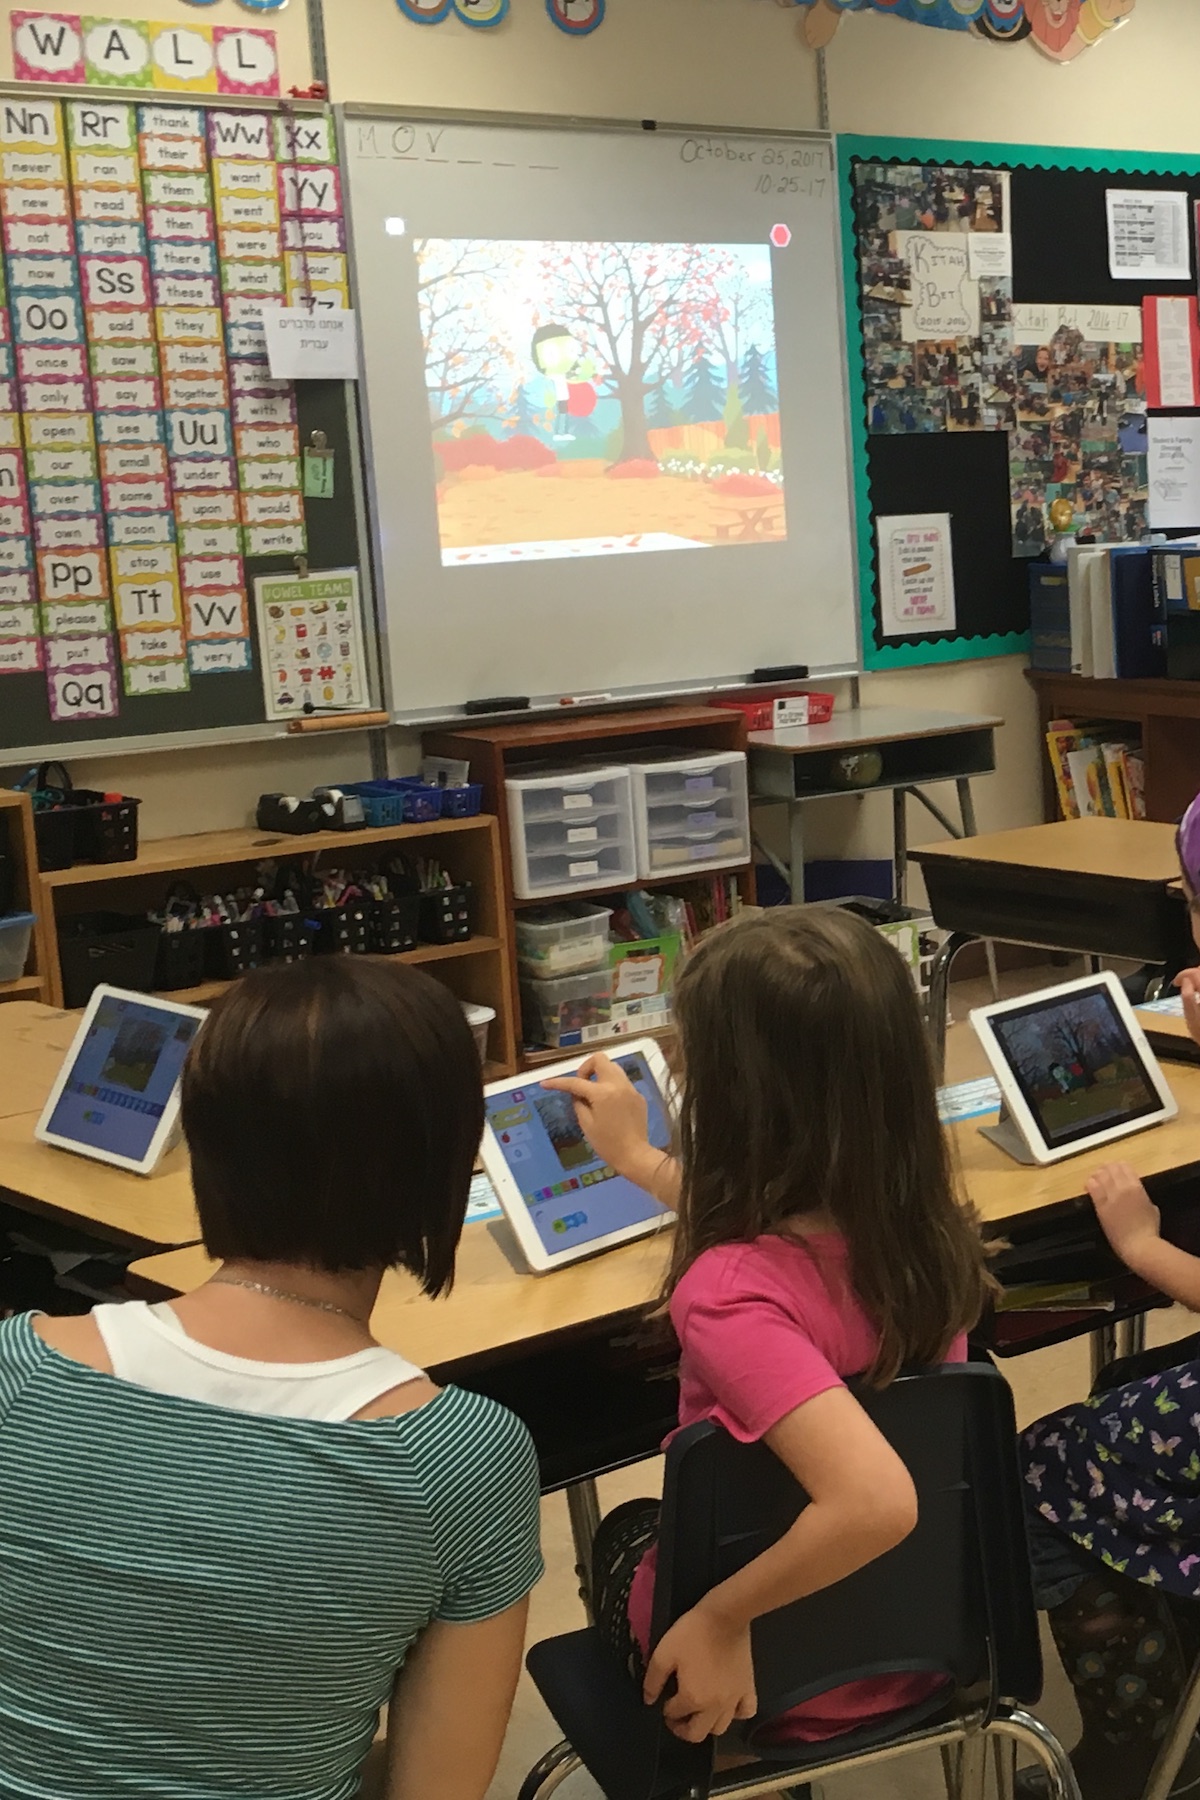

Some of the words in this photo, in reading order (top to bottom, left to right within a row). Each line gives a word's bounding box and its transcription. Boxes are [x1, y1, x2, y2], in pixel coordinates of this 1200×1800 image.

[5, 107, 49, 135] Nn
[80, 111, 119, 137] Rr
[153, 116, 190, 128] thank
[216, 121, 264, 144] Ww
[285, 126, 322, 150] Xx
[157, 148, 188, 160] their
[680, 139, 757, 163] October
[12, 163, 52, 173] never
[93, 165, 117, 175] ran
[230, 172, 261, 183] want
[161, 183, 194, 195] them
[289, 177, 328, 207] Yy
[22, 199, 48, 208] new
[94, 199, 124, 210] read
[233, 206, 263, 216] went
[165, 217, 193, 229] then
[28, 233, 49, 243] not
[94, 233, 126, 247] right
[301, 232, 323, 244] you
[236, 240, 267, 250] were
[164, 252, 200, 264] there
[28, 269, 55, 278] now
[239, 273, 268, 284] what
[96, 268, 135, 294] Ss
[166, 287, 203, 298] these
[240, 304, 263, 316] whe
[26, 304, 68, 330] Oo
[1012, 307, 1049, 327] Kitah
[109, 319, 134, 331] said
[174, 320, 204, 333] they
[35, 358, 68, 368] once
[112, 356, 136, 366] saw
[179, 352, 208, 364] think
[40, 390, 69, 404] only
[115, 390, 137, 401] say
[173, 388, 219, 401] together
[250, 404, 278, 416] with
[42, 427, 76, 439] open
[117, 425, 140, 434] see
[178, 420, 218, 445] Uu
[257, 437, 281, 448] who
[50, 461, 73, 470] our
[119, 455, 150, 468] small
[184, 468, 221, 480] under
[260, 468, 284, 481] why
[50, 495, 80, 505] over
[120, 491, 152, 502] some
[193, 505, 222, 516] upon
[257, 502, 291, 514] would
[54, 529, 83, 539] own
[124, 525, 155, 535] soon
[203, 537, 218, 546] us
[261, 534, 294, 545] write
[130, 556, 159, 569] stop
[51, 562, 93, 592] Pp
[200, 569, 221, 579] use
[264, 585, 304, 599] VOWEL
[309, 582, 351, 596] TEAMS
[131, 589, 161, 615] Tt
[56, 613, 97, 627] please
[194, 602, 237, 627] Vv
[140, 639, 168, 651] take
[67, 648, 90, 659] put
[204, 652, 233, 664] very
[147, 671, 167, 684] tell
[62, 681, 105, 710] Qq
